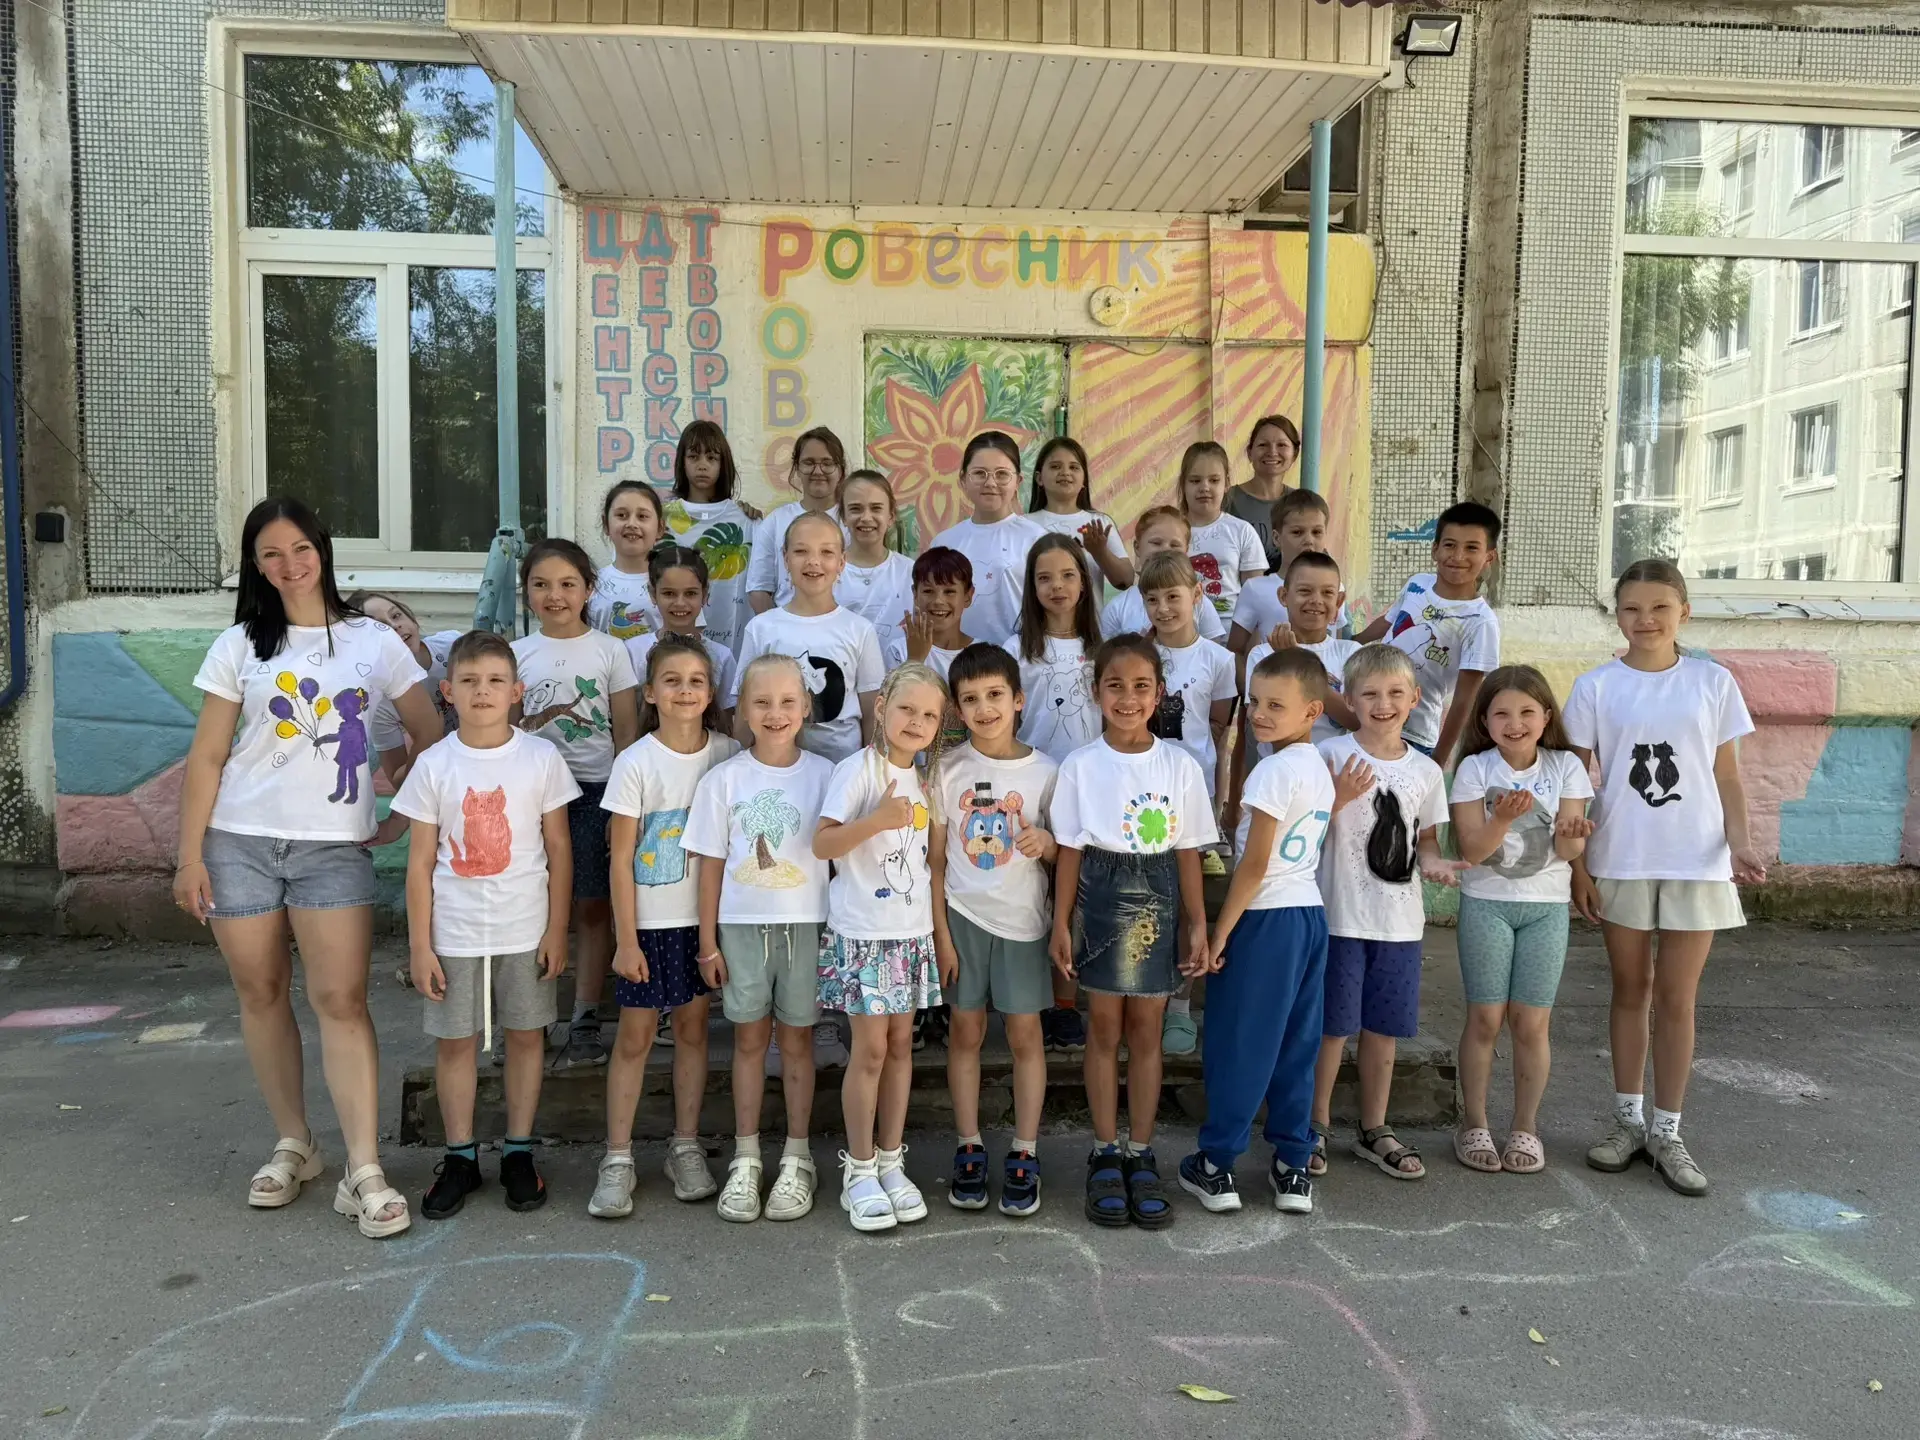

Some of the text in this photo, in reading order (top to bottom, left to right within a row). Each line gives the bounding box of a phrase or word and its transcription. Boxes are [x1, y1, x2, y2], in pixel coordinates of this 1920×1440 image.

[583, 205, 635, 473] ЦЕНТР
[636, 205, 682, 499] ДЕТСКО
[683, 207, 730, 439] ТВОРЧ
[1279, 808, 1332, 864] 67
[1533, 778, 1552, 796] 67
